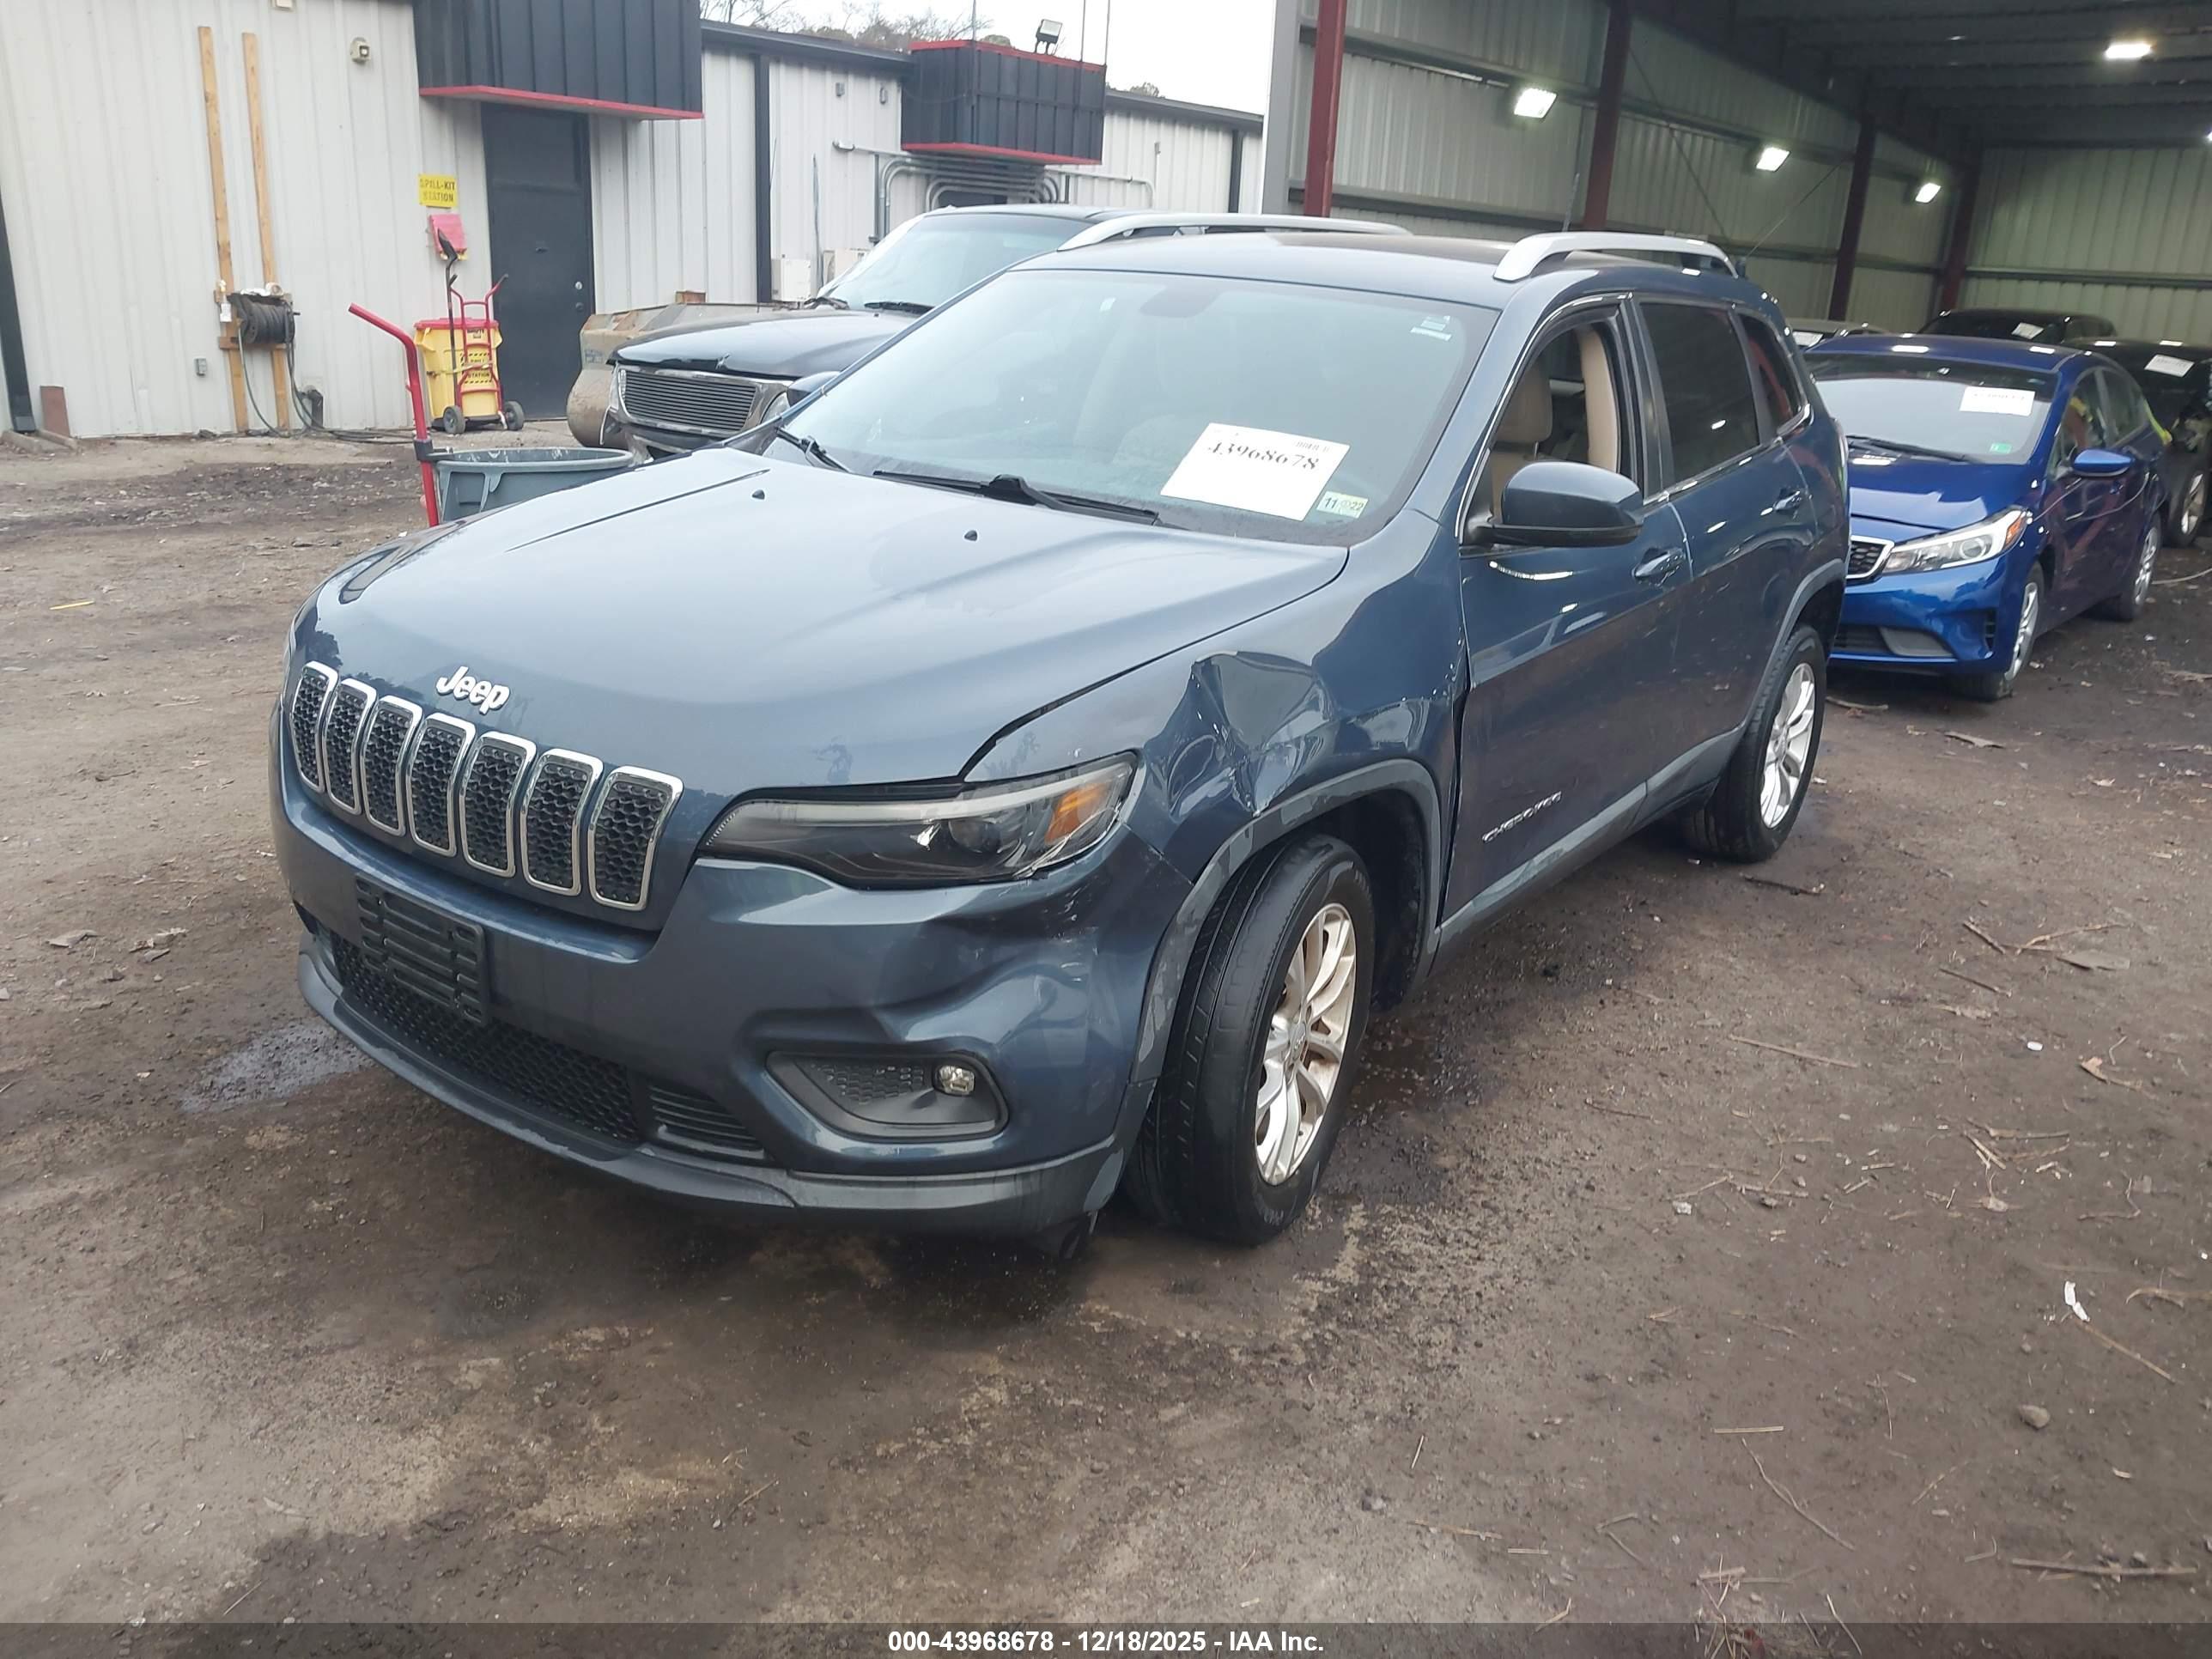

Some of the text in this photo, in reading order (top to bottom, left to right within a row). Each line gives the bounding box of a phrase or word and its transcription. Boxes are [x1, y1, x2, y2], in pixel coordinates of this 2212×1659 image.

[1207, 441, 1319, 470] 43968678
[1325, 498, 1338, 509] 11
[436, 665, 510, 714] Jeep
